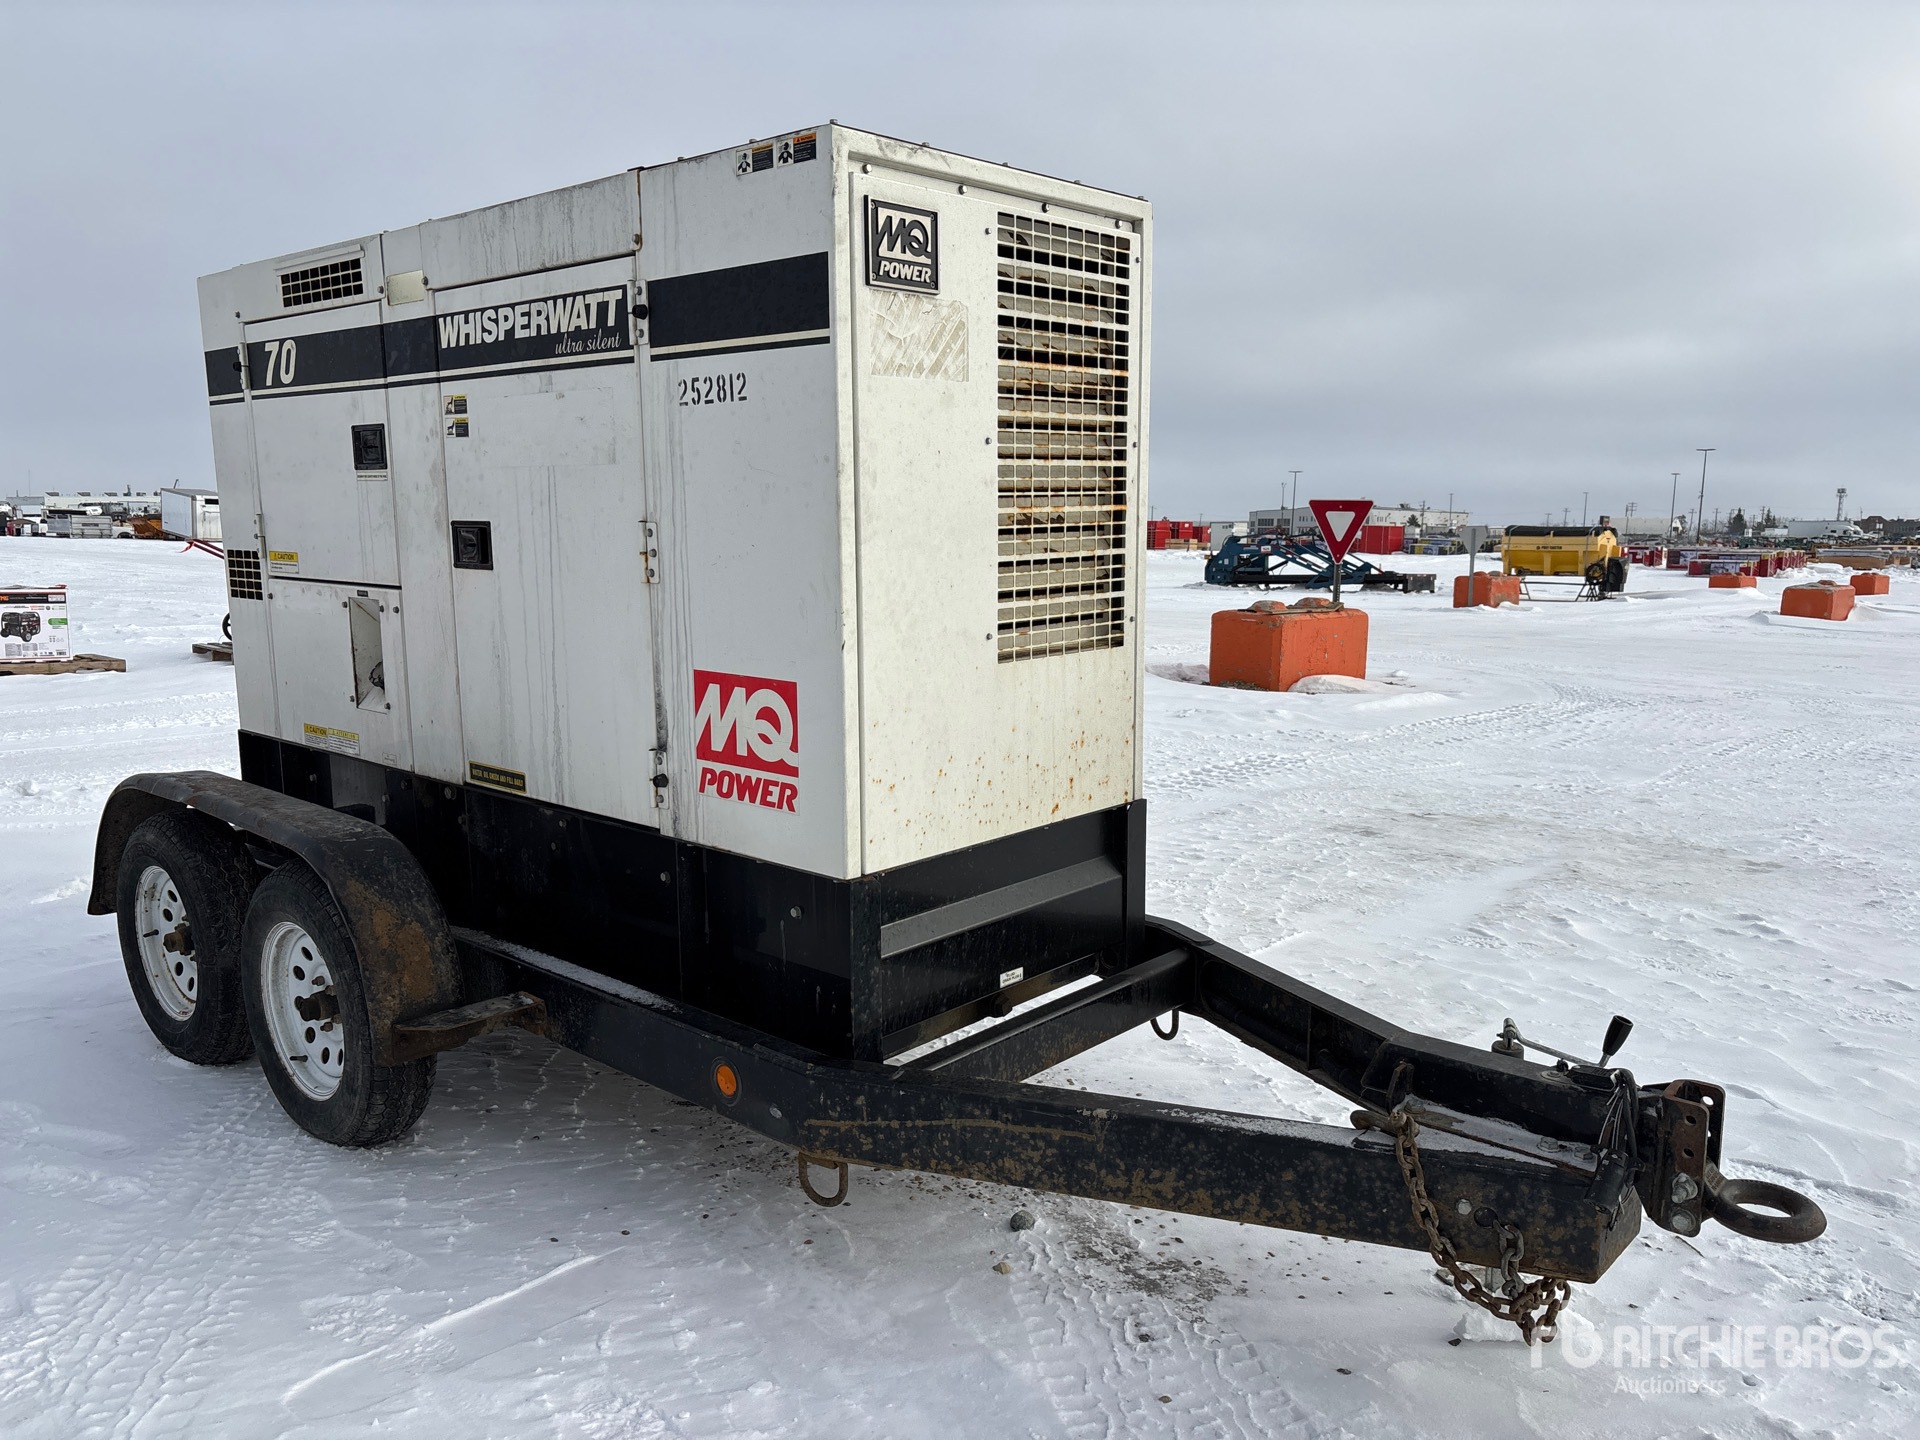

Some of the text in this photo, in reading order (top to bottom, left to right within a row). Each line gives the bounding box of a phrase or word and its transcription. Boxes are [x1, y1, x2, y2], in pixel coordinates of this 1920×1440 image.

[876, 215, 931, 259] MQ
[879, 260, 932, 283] POWER
[438, 289, 623, 349] WHISPERWATT
[264, 339, 297, 386] 70
[555, 329, 622, 355] ultra silent
[678, 372, 748, 407] 252812
[694, 683, 799, 768] MQ
[698, 766, 799, 813] POWER
